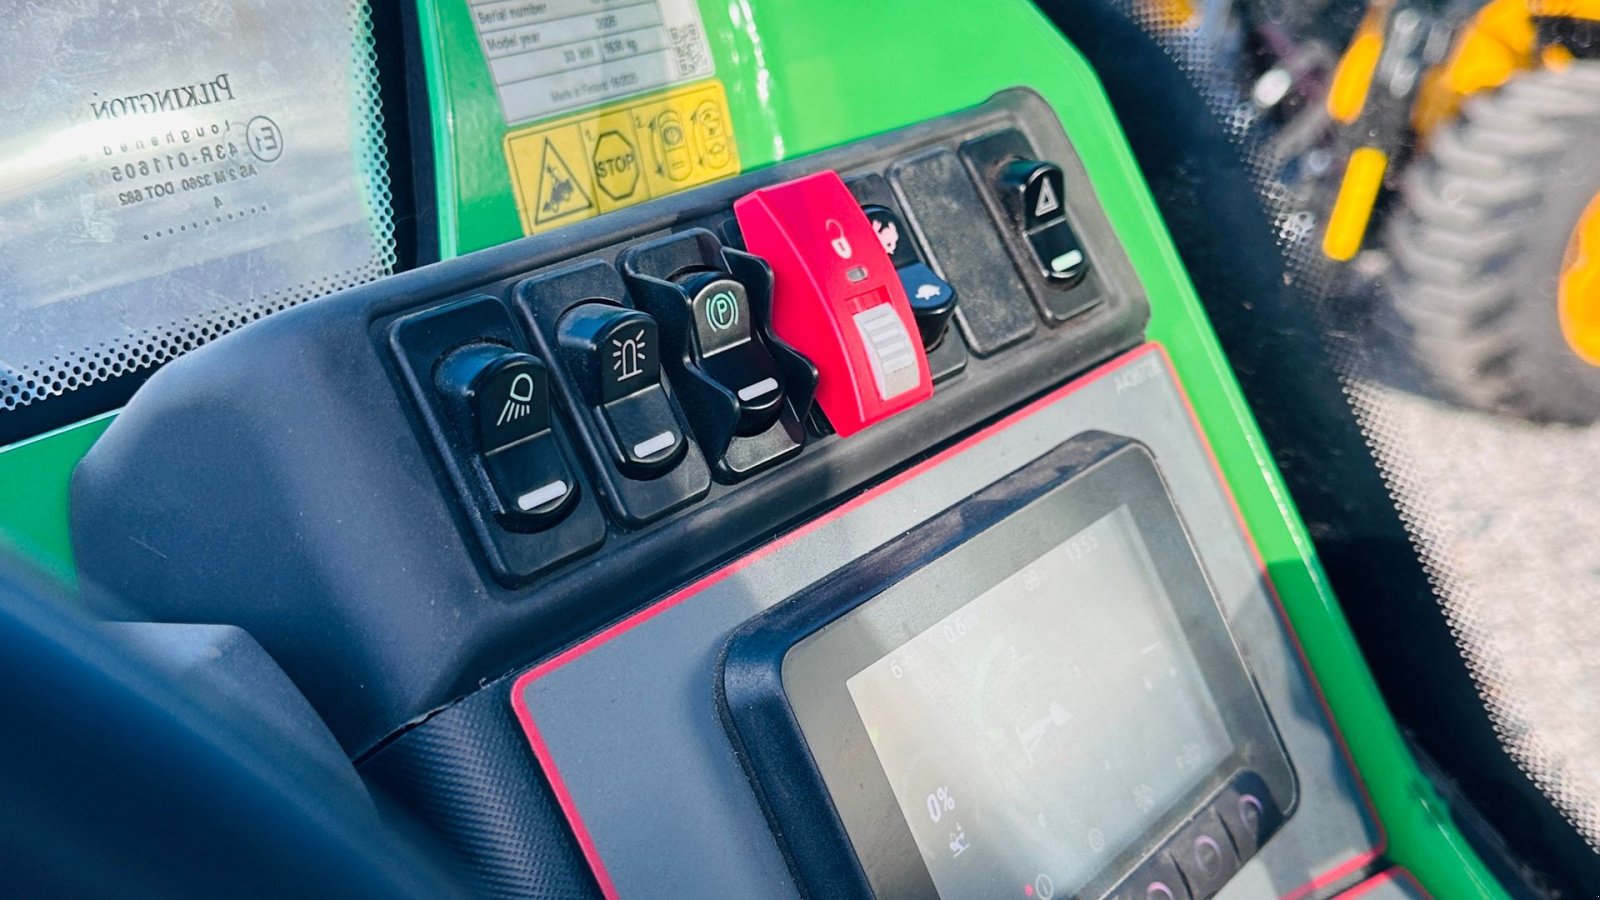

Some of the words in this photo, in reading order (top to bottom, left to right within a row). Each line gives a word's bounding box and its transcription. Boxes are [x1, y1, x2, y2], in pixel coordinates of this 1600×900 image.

[477, 8, 508, 25] Serial
[509, 4, 547, 19] number
[486, 34, 518, 51] Model
[520, 32, 541, 48] year
[596, 152, 635, 178] STOP
[926, 785, 956, 824] 0%
